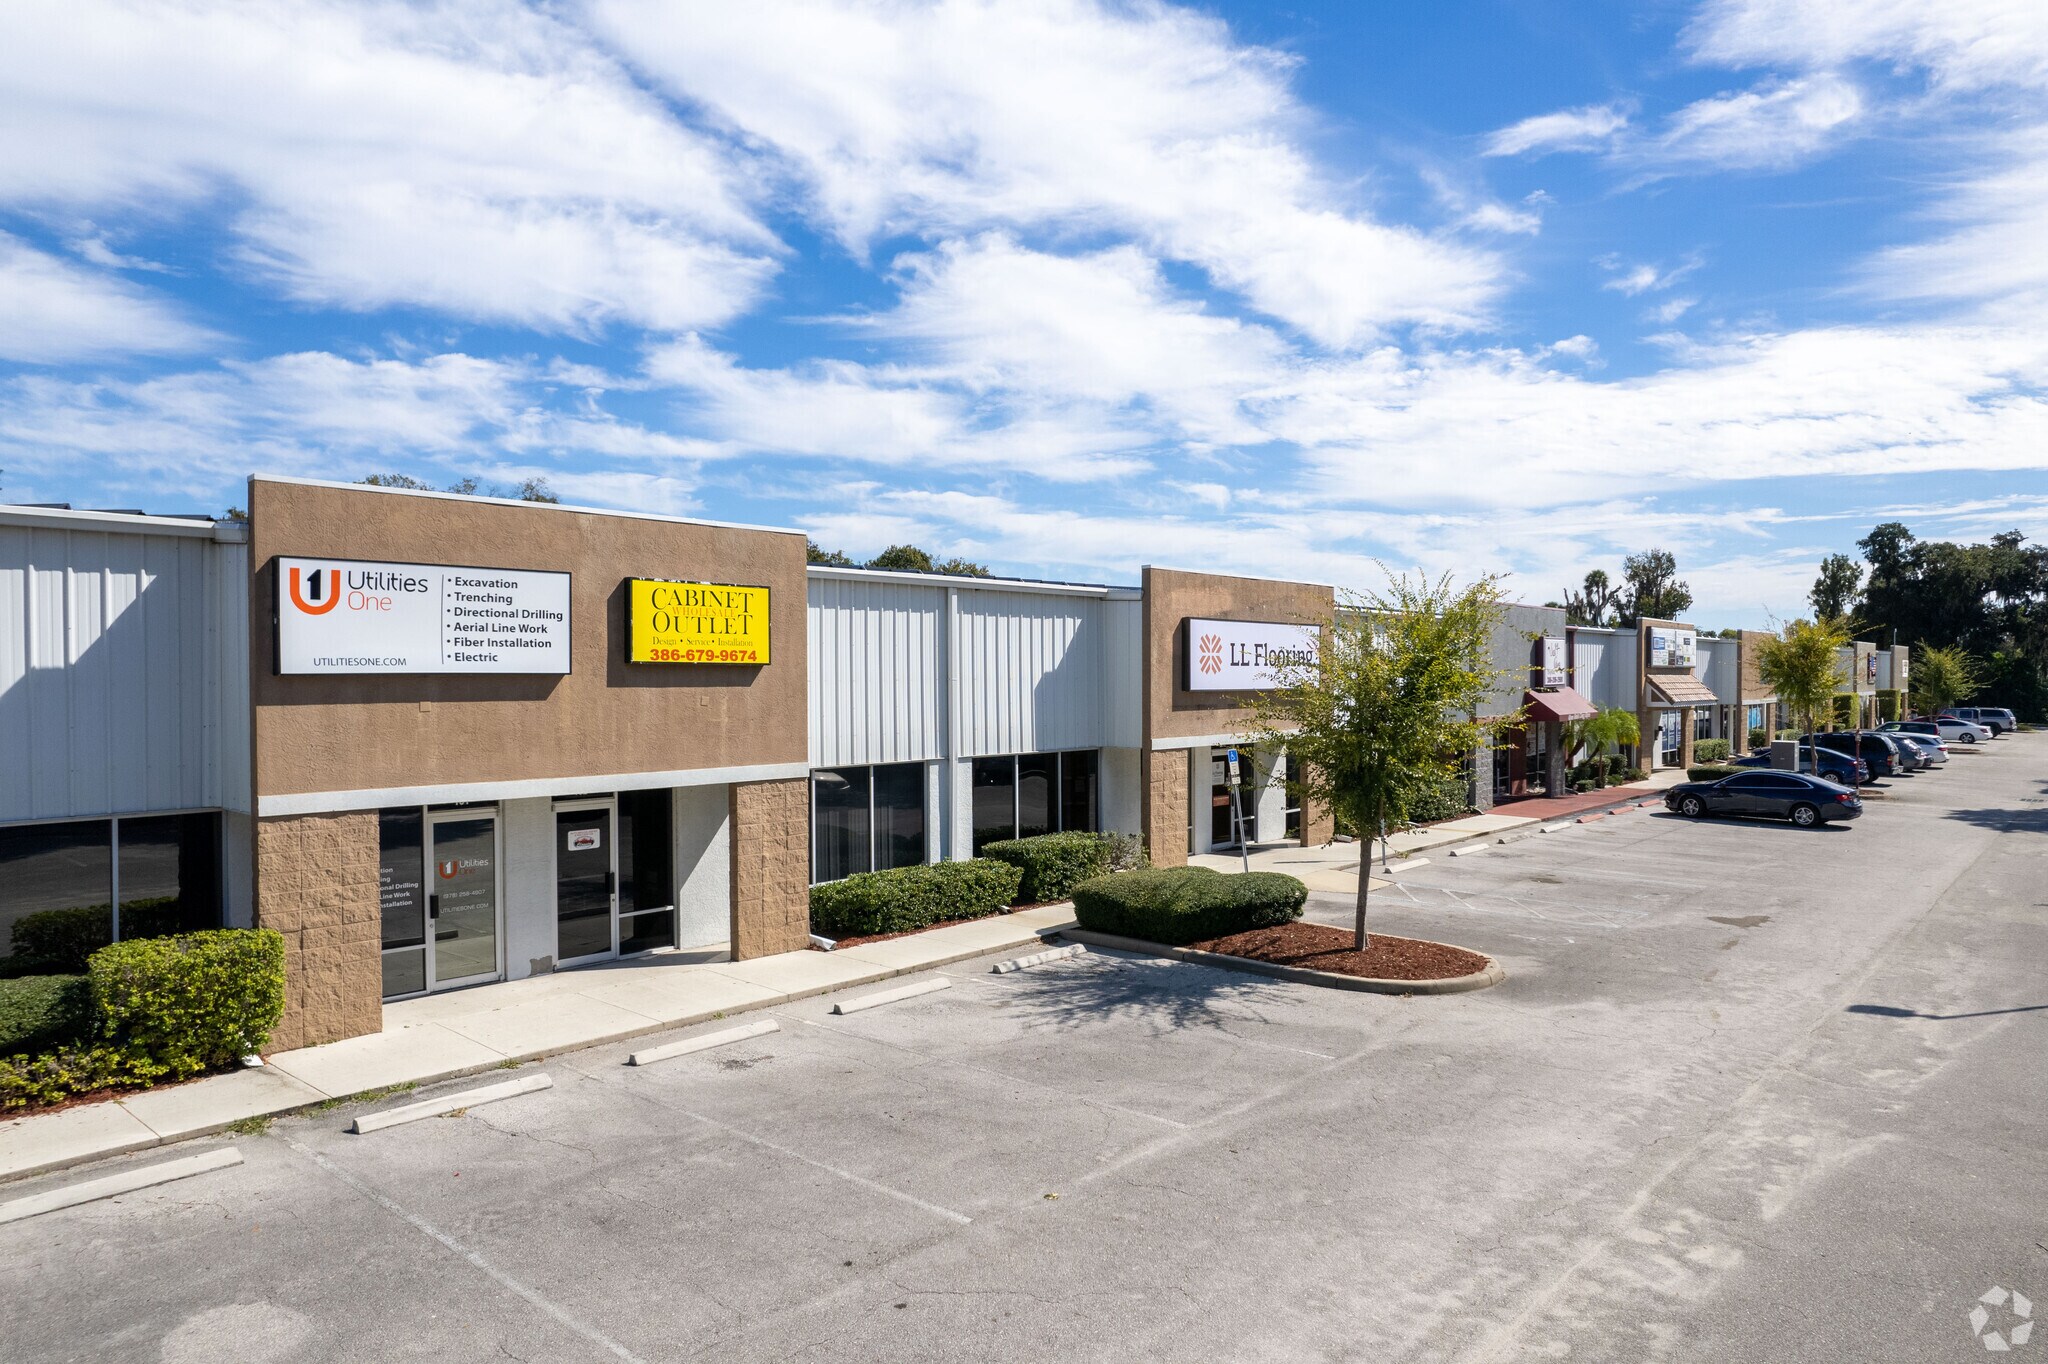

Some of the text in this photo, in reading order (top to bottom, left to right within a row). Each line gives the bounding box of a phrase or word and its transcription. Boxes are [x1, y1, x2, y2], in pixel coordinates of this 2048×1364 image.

[347, 570, 428, 593] Utilities
[454, 576, 518, 589] Excavation
[347, 591, 392, 611] One
[454, 591, 513, 606] Trenching
[651, 587, 754, 613] CABINET
[454, 606, 563, 622] Directional Drilling
[672, 606, 735, 618] WHOLESALE
[453, 622, 548, 634] Aerial Line Work
[652, 611, 753, 635] OUTLET
[454, 637, 552, 648] Fiber Installation
[652, 636, 753, 647] Design Service Installation
[454, 652, 498, 662] Electric
[650, 648, 757, 662] 386-679-9674
[1230, 642, 1250, 667] LL
[313, 657, 407, 667] UTILITIESONE.COM
[459, 858, 489, 868] Utilities
[395, 882, 419, 890] Drilling
